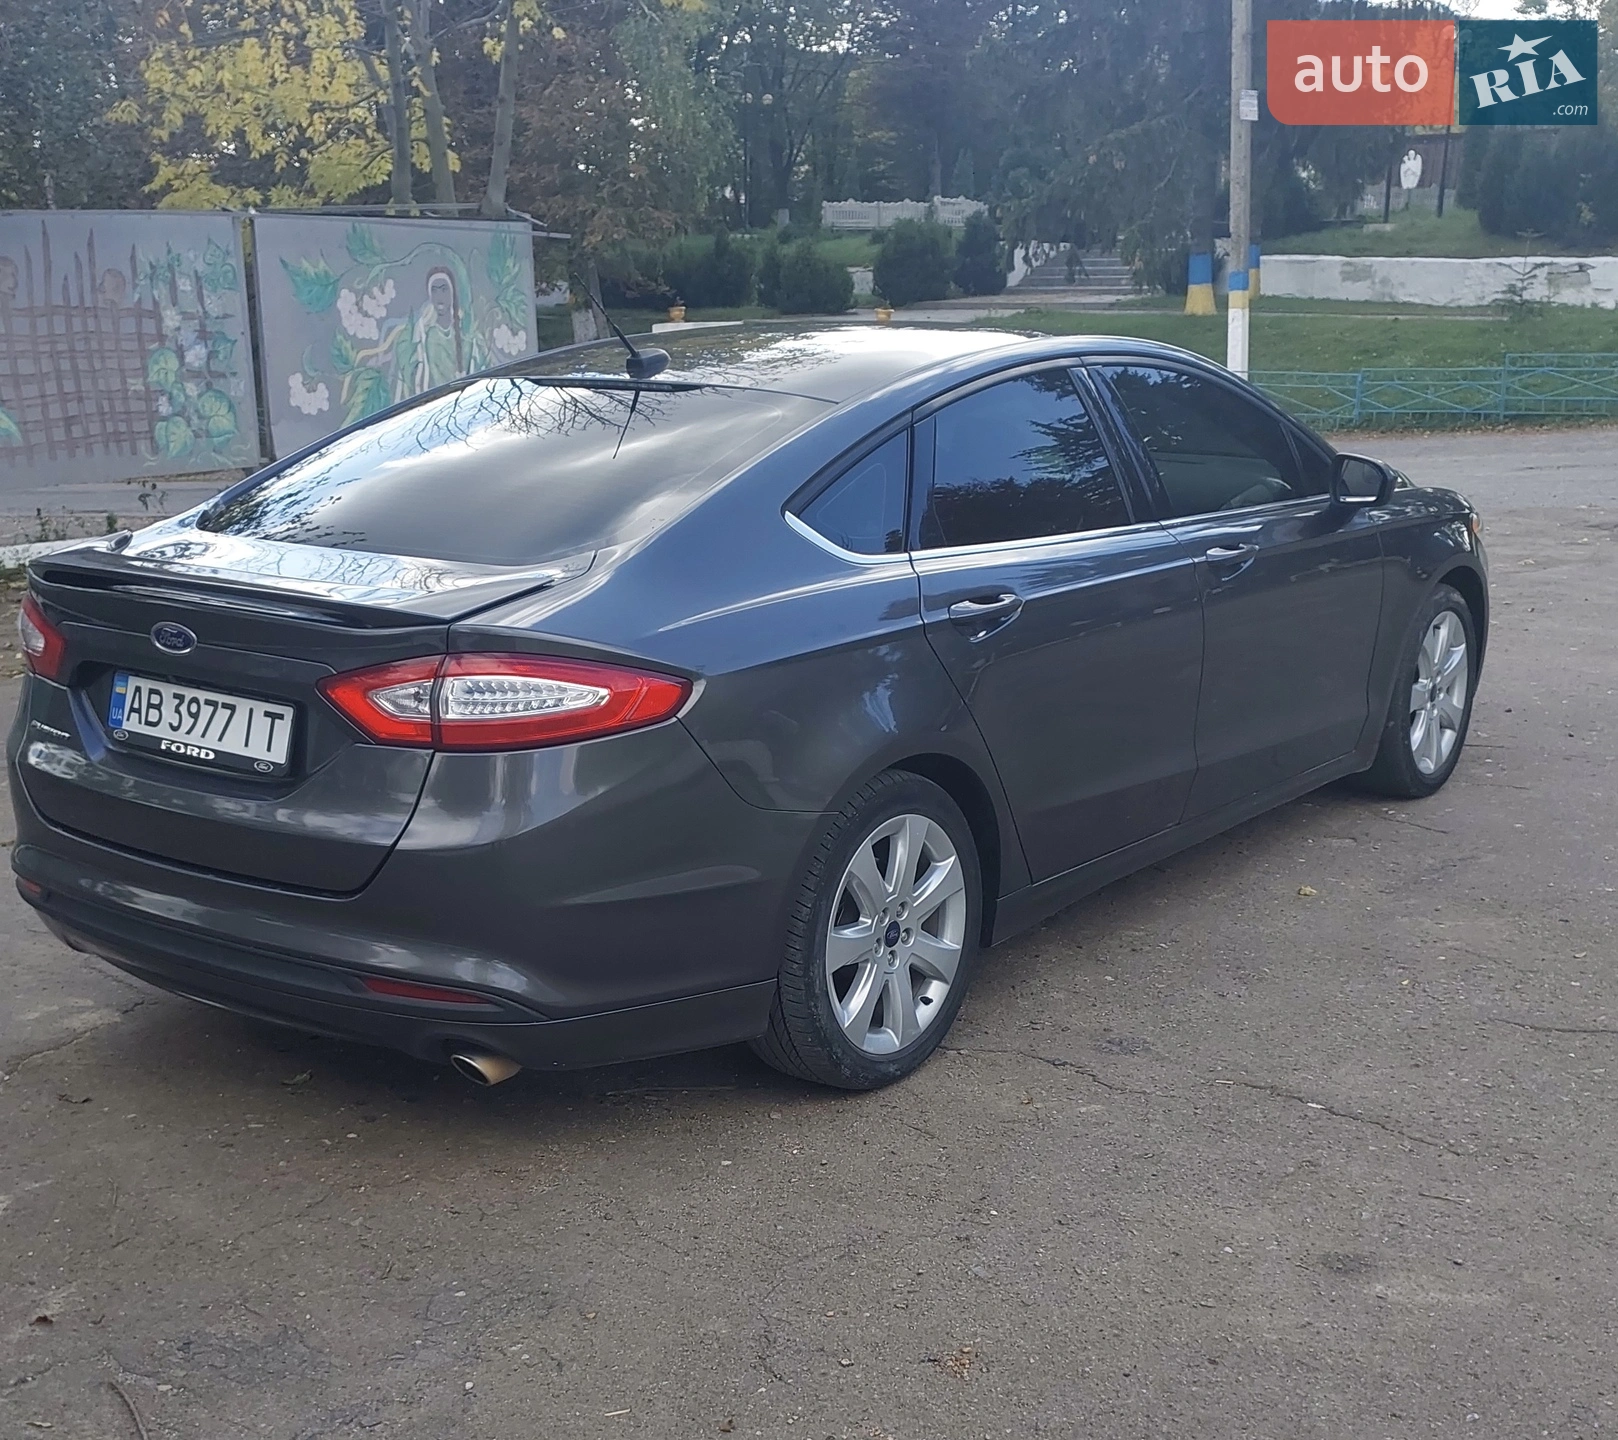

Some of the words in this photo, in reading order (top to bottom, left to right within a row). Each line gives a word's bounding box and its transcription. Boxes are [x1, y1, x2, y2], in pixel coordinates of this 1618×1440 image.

[159, 626, 185, 647] Ford
[111, 705, 123, 720] UA
[126, 685, 164, 728] AB
[168, 692, 237, 743] 3977
[244, 707, 285, 753] IT
[160, 739, 216, 761] FORD
